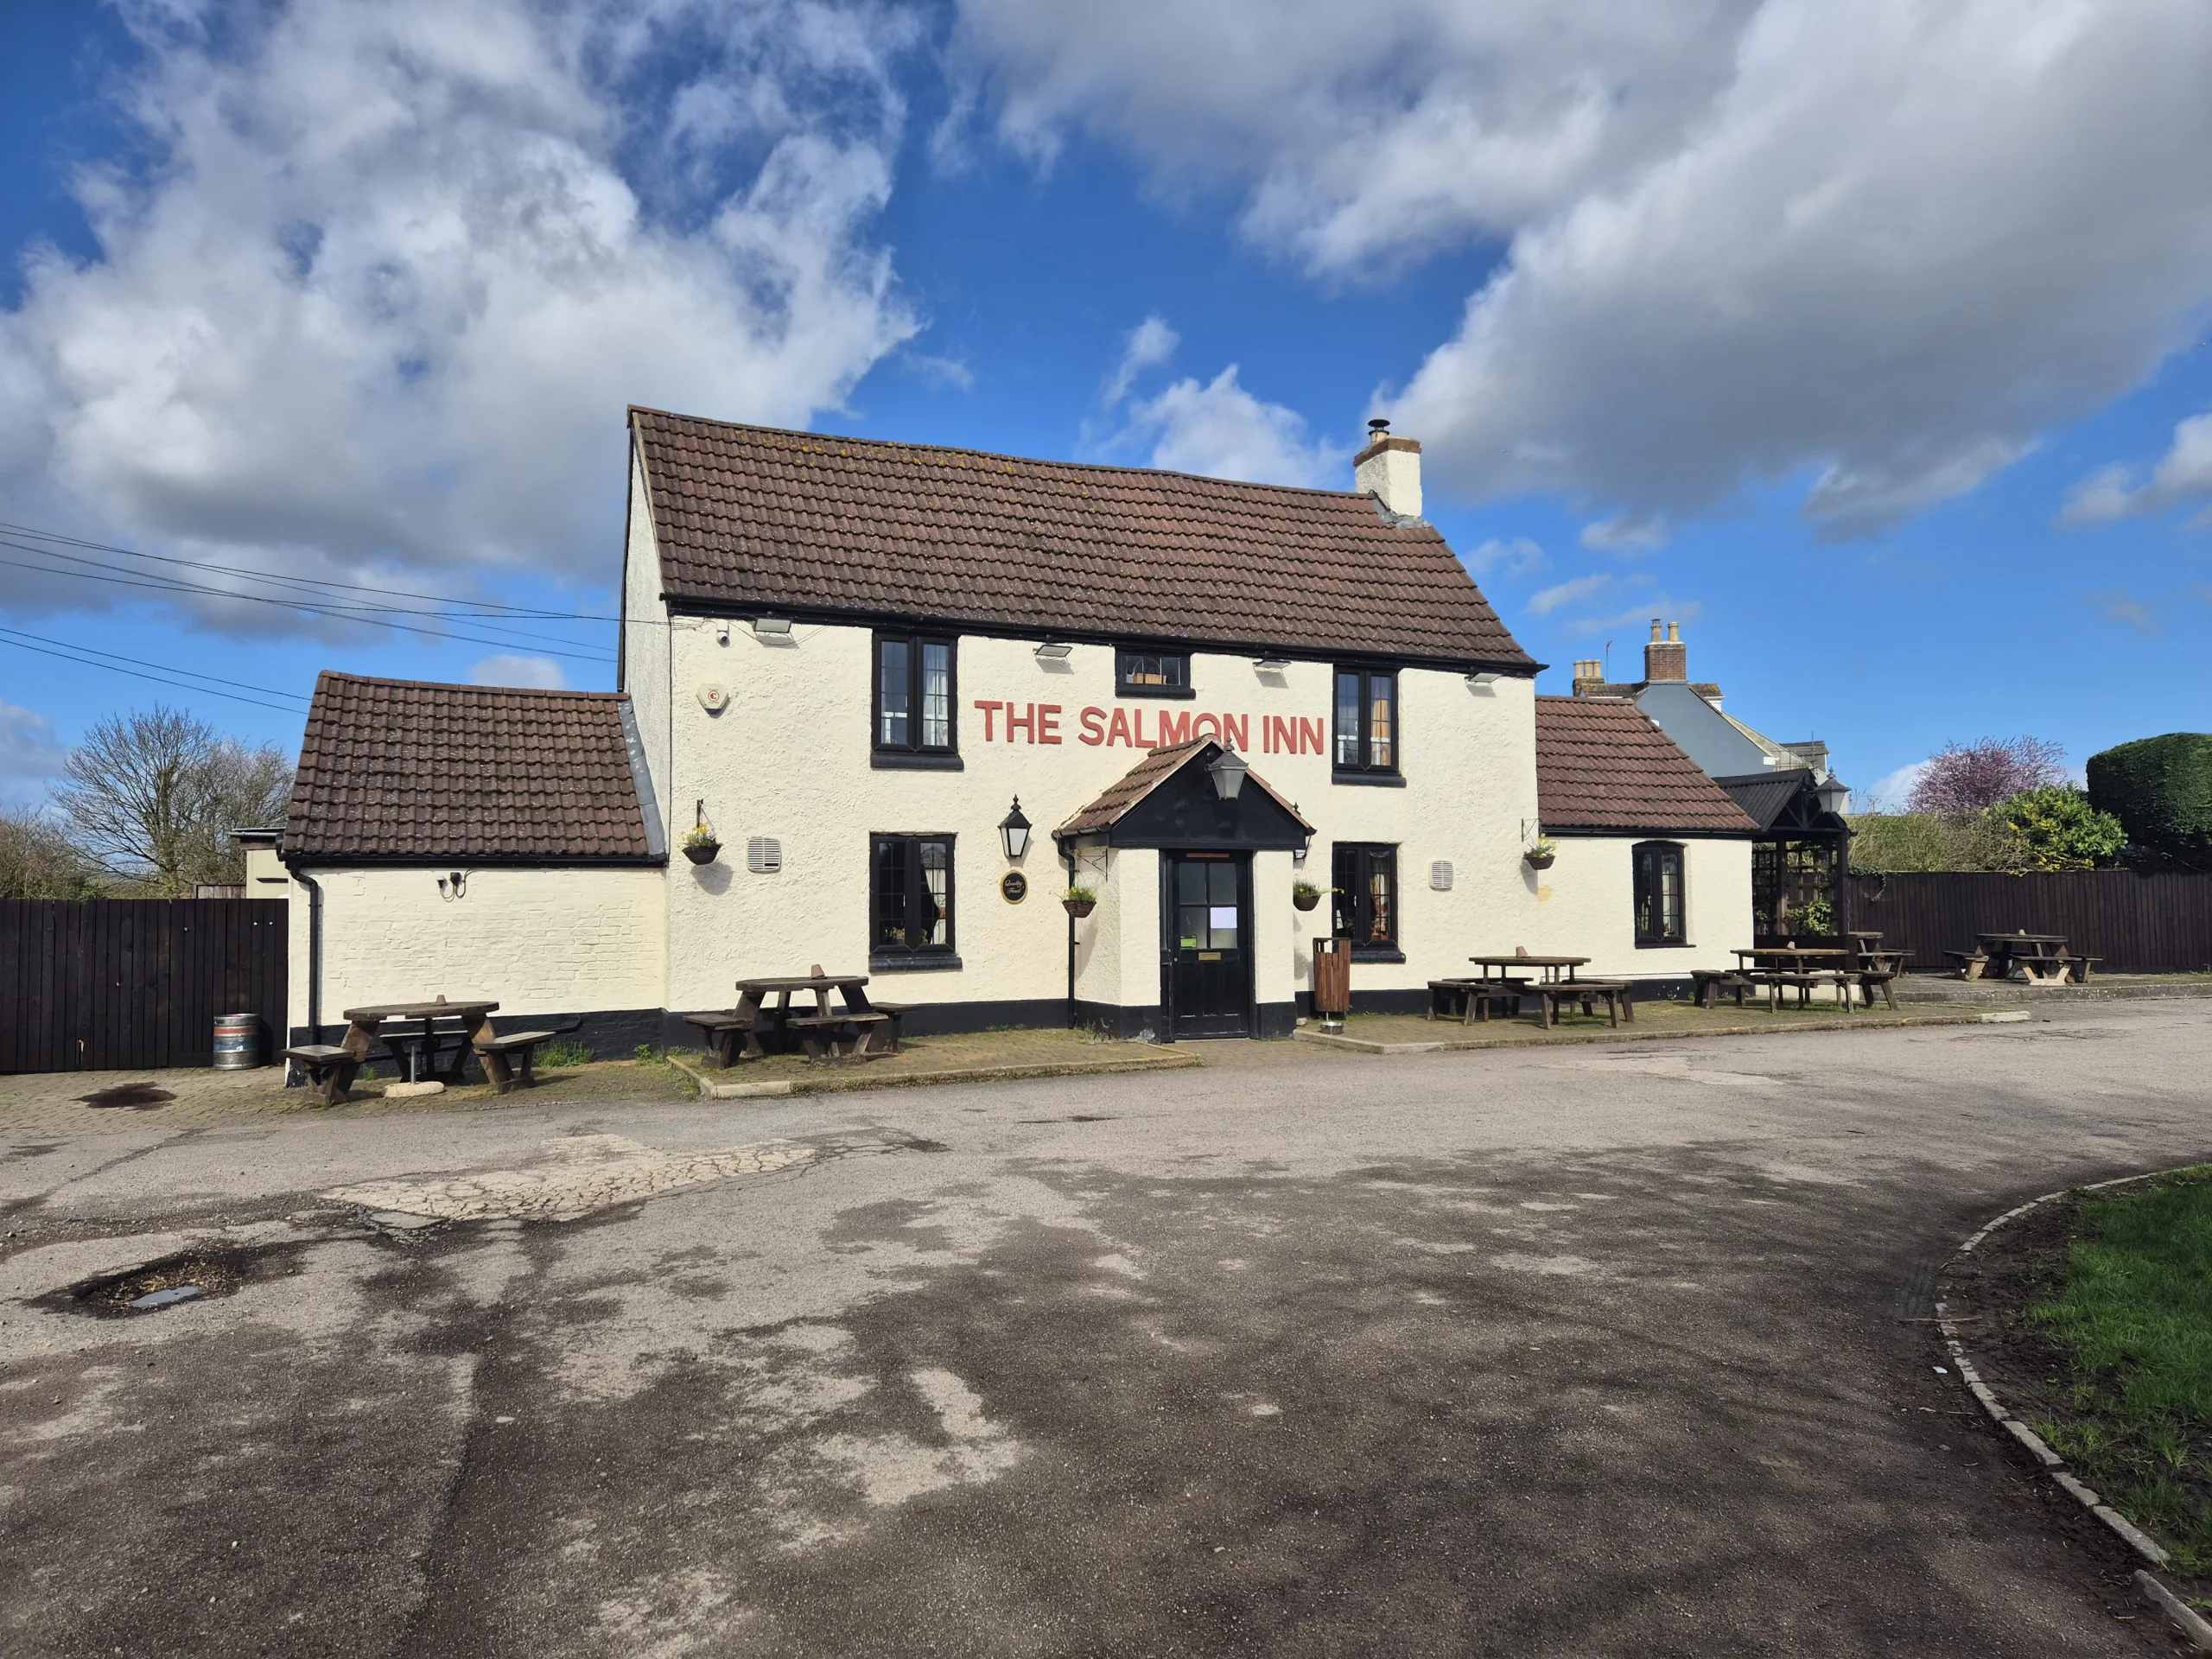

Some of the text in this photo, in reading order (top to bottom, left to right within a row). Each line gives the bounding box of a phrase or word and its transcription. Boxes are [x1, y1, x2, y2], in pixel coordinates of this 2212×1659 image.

[974, 701, 1324, 754] THE SALMON INN
